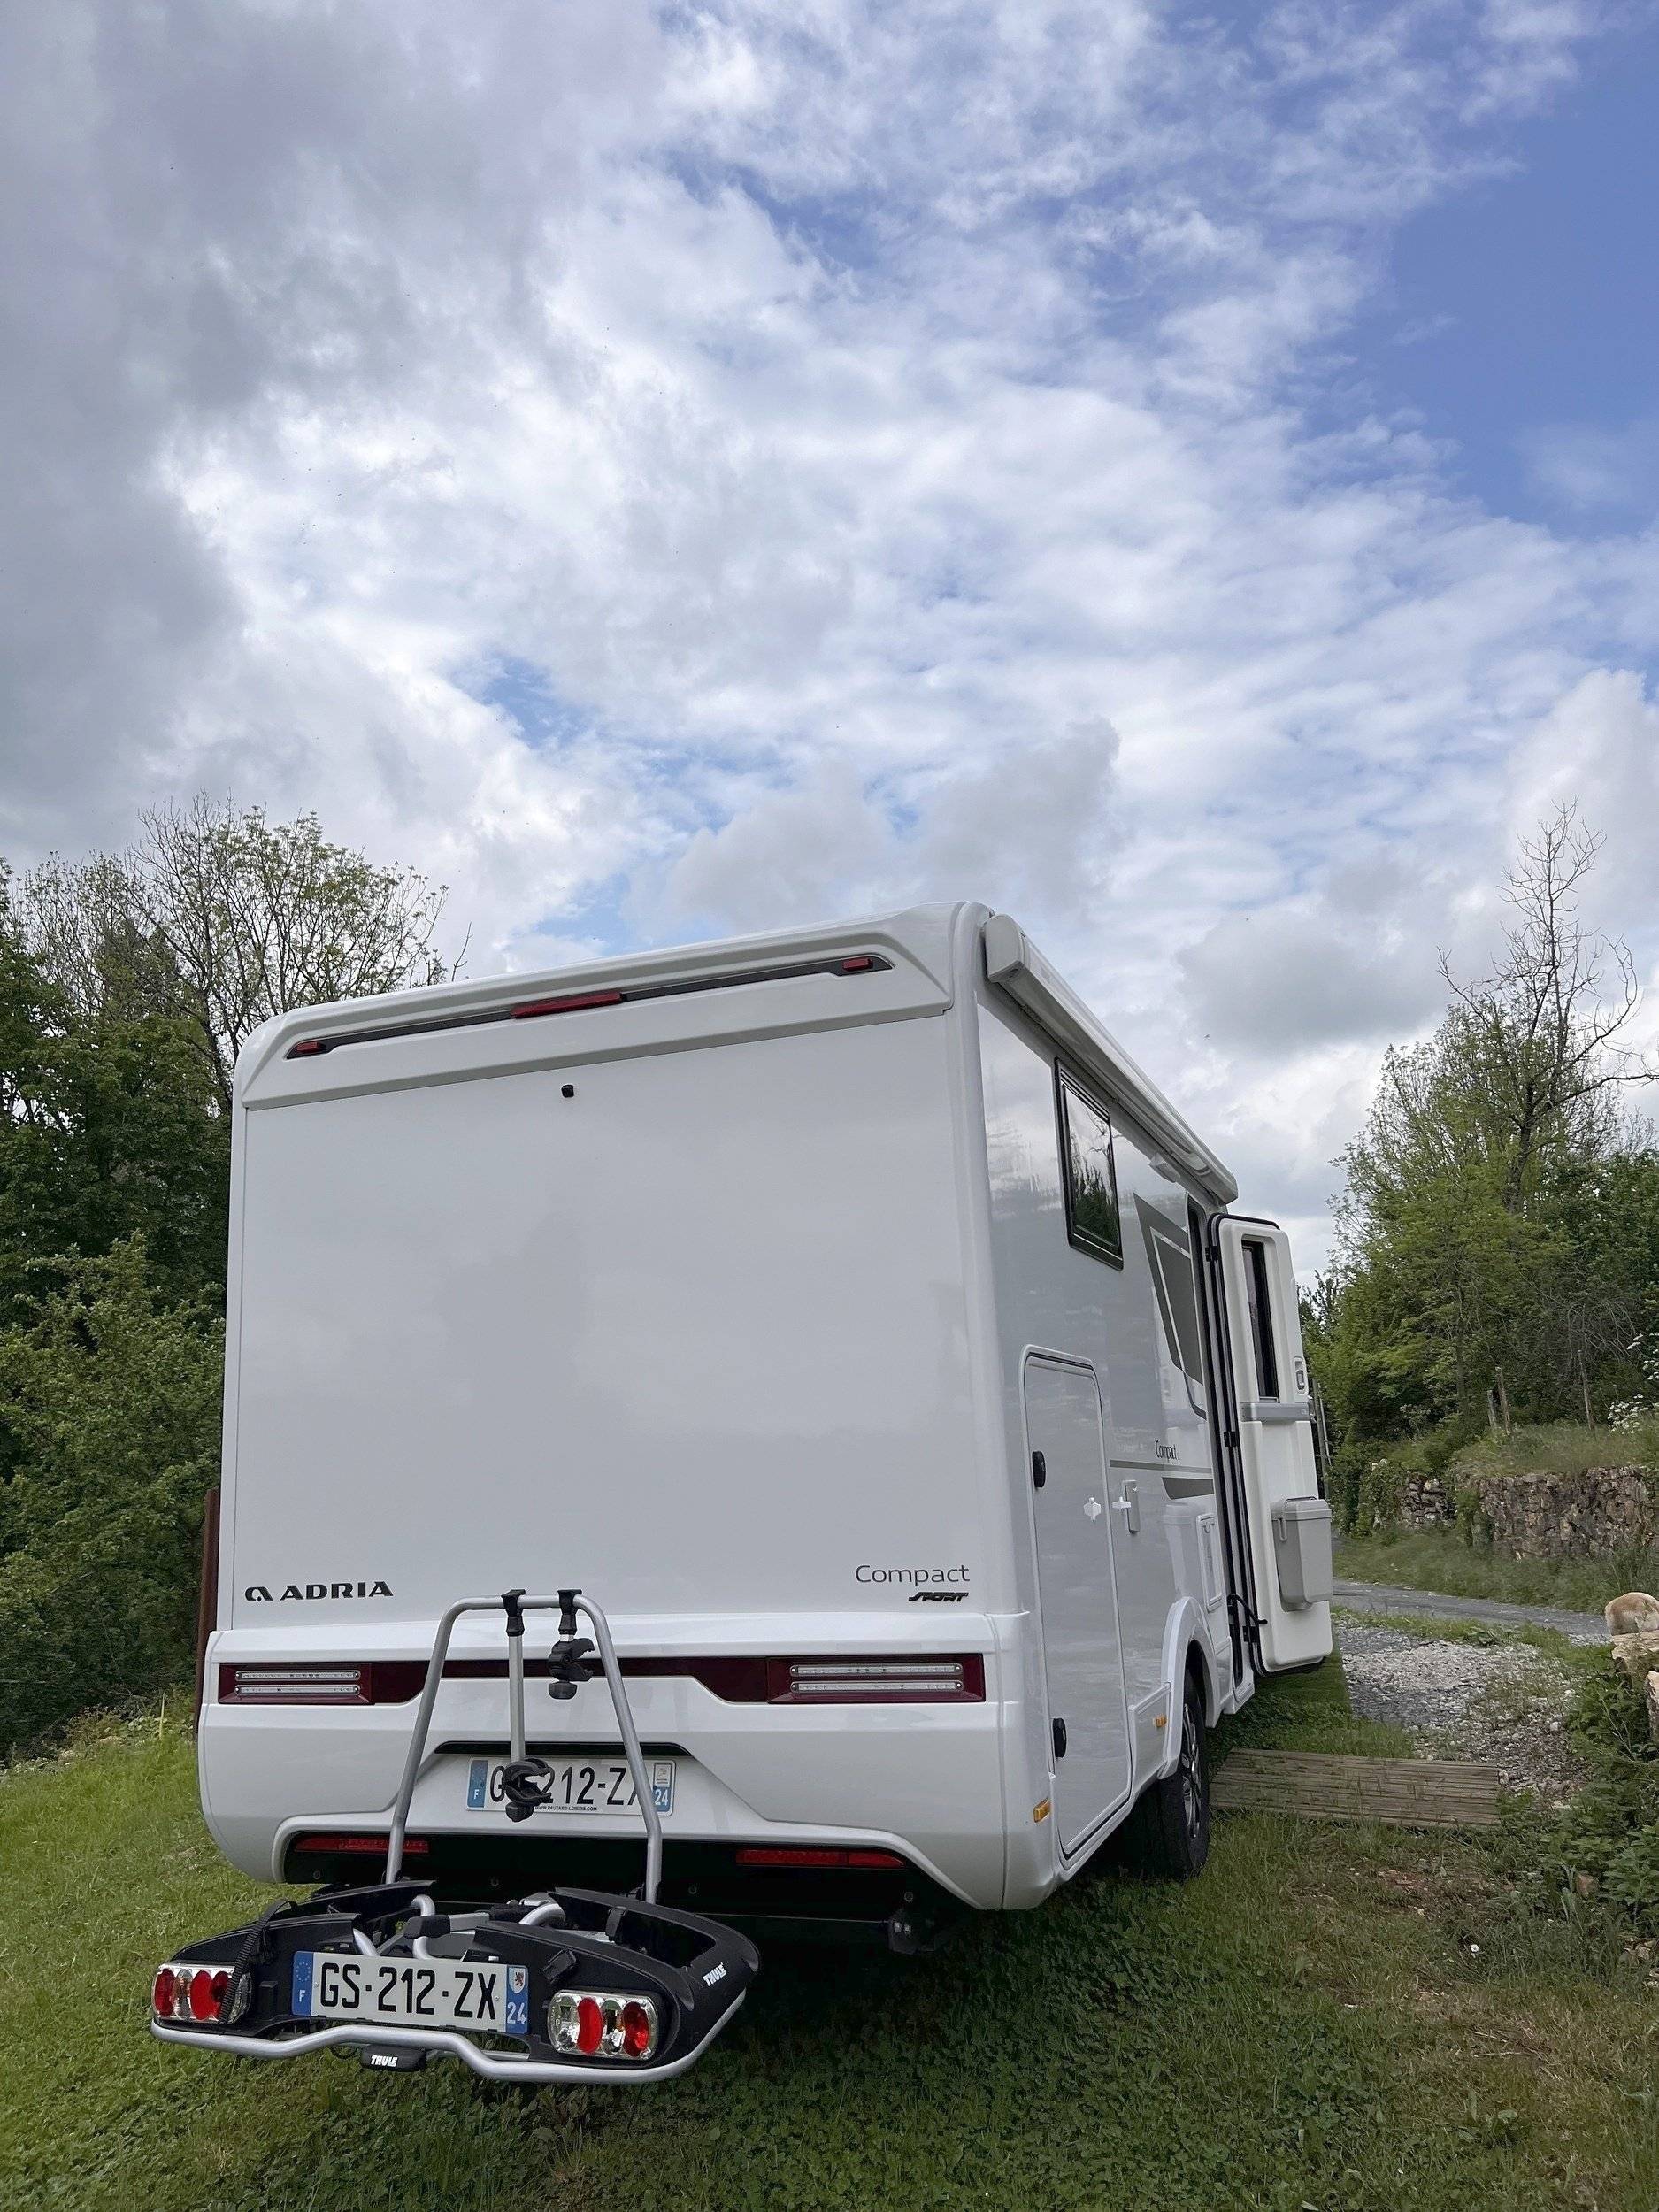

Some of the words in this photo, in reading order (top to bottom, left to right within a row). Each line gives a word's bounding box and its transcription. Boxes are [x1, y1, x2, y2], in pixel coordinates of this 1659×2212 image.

[855, 1564, 971, 1586] Compact
[280, 1581, 394, 1601] ADRIA
[473, 1788, 480, 1800] F
[654, 1788, 670, 1806] 24
[703, 1962, 727, 1987] THULE
[298, 1989, 306, 2003] F
[319, 1962, 497, 2021] GS-212-ZX
[506, 2001, 527, 2025] 24
[370, 2055, 398, 2068] THULE
